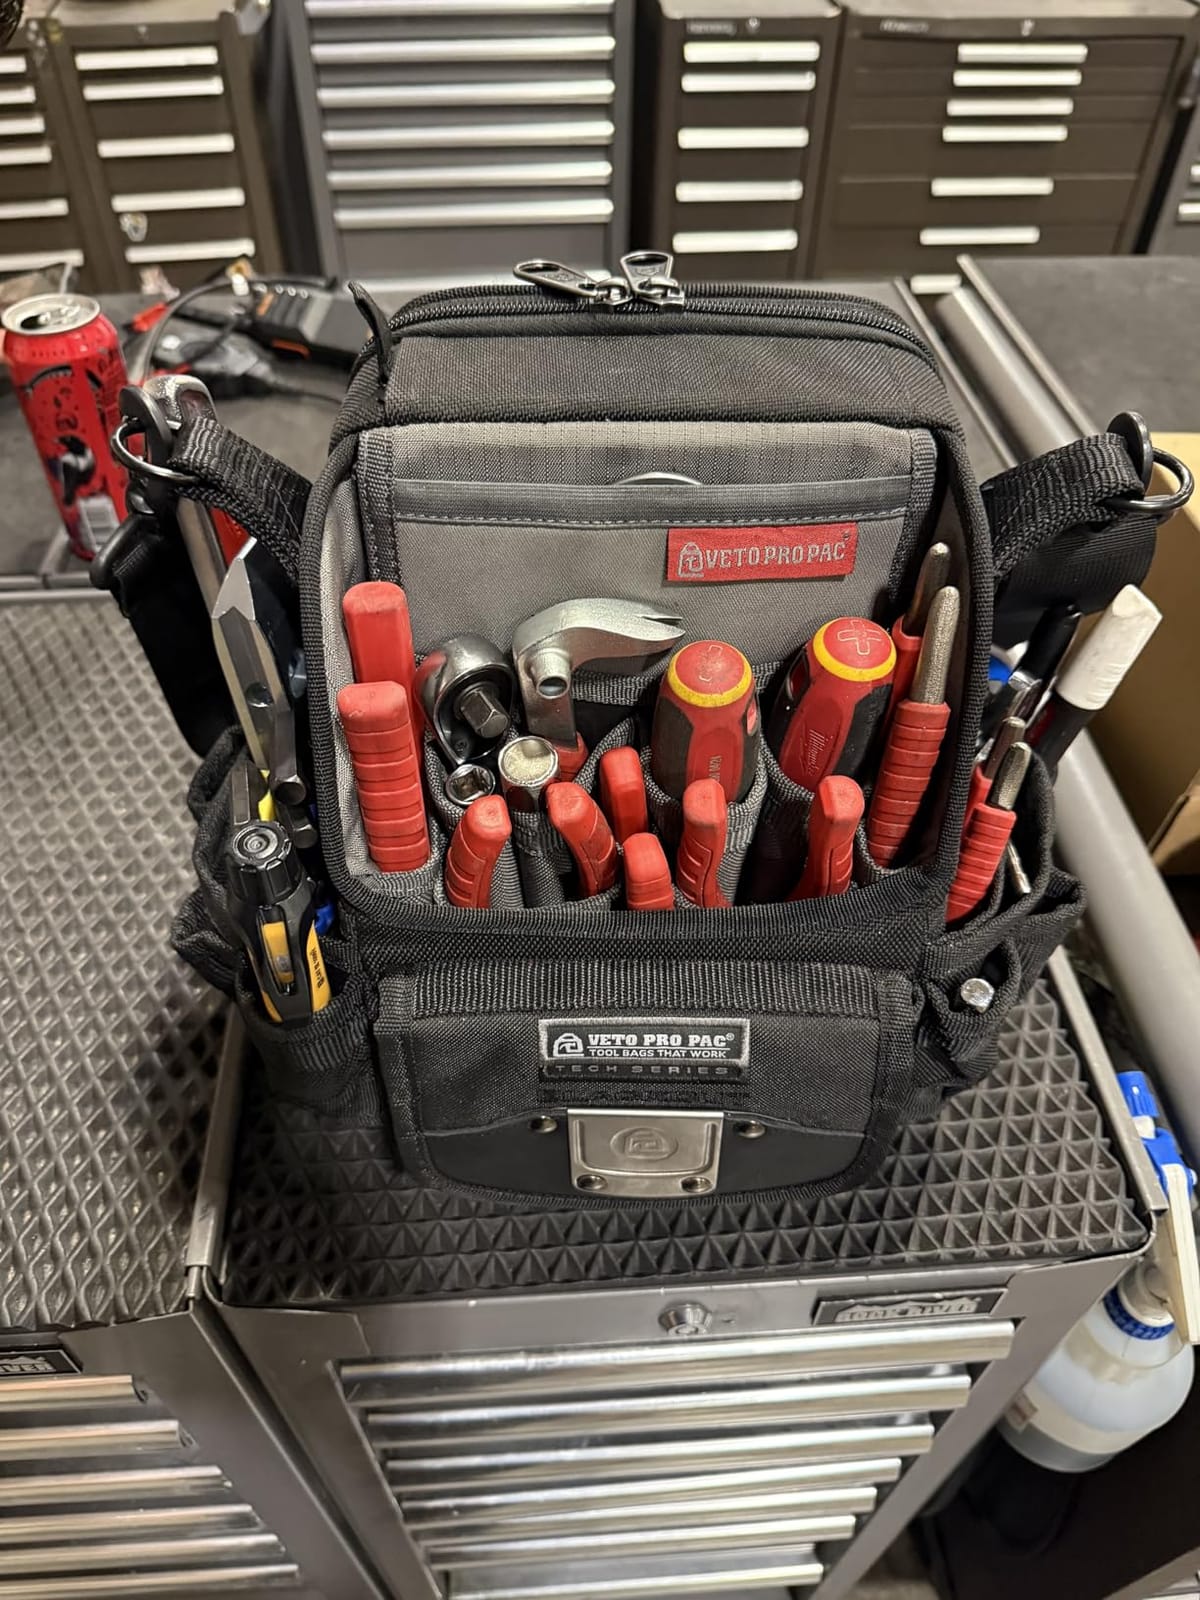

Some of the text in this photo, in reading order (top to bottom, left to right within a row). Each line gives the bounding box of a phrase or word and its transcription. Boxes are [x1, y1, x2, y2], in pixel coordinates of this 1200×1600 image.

[705, 546, 759, 569] VETO
[763, 543, 804, 566] PRO
[588, 1033, 638, 1047] VETO
[643, 1033, 682, 1047] PRO
[589, 1049, 727, 1059] TOOL BAGS THAT WORK
[555, 1064, 729, 1075] TECH SERIES
